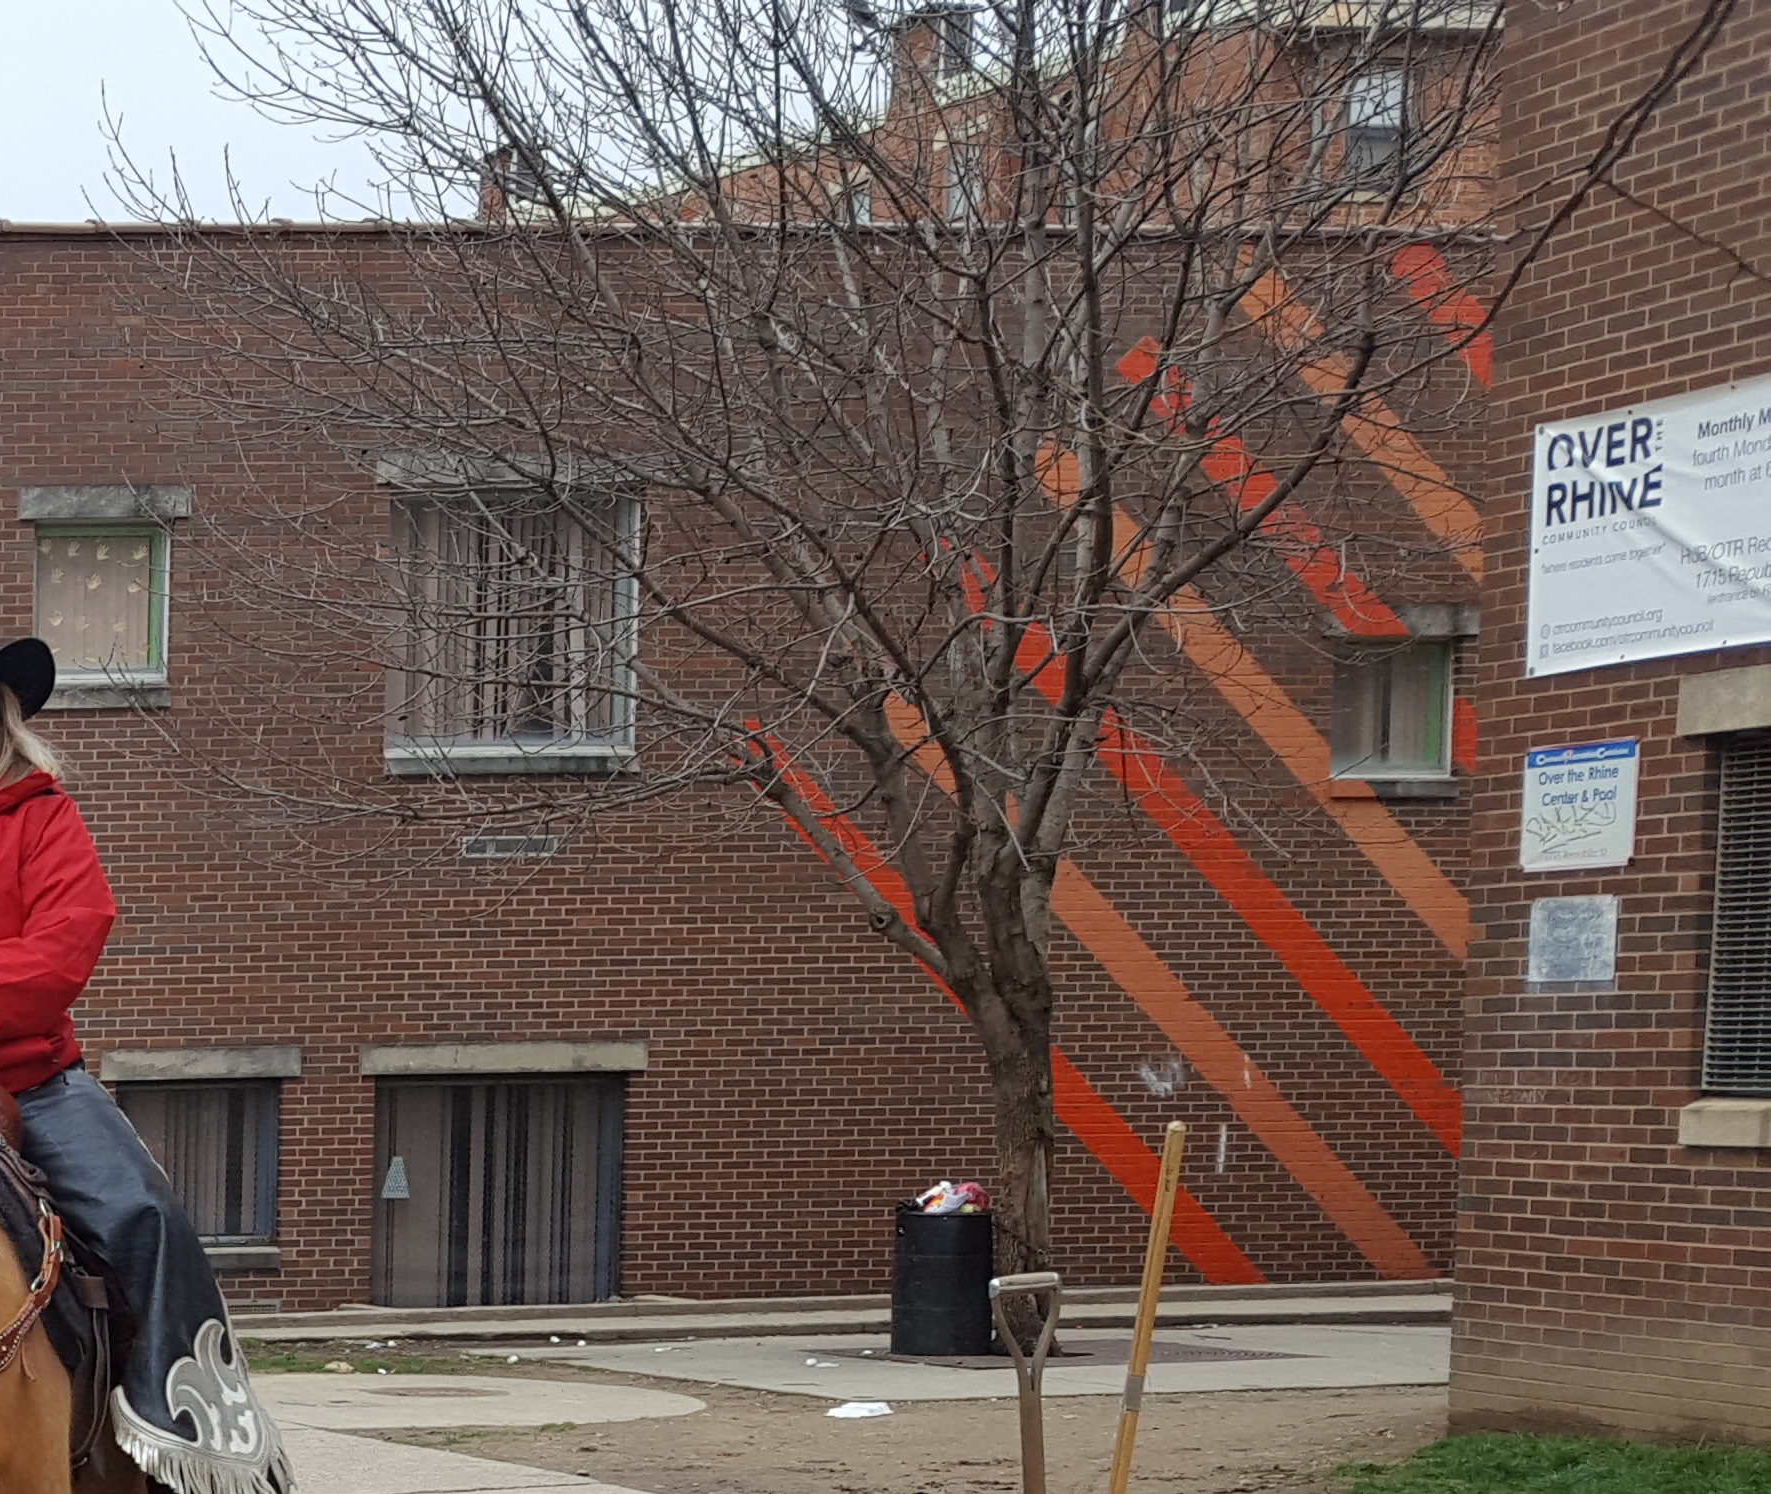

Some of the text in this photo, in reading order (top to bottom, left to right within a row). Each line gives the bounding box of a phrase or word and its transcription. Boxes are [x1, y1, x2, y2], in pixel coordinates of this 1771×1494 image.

[1698, 412, 1755, 440] Monthly
[1547, 417, 1653, 471] OVER
[1692, 444, 1730, 466] fourth
[1704, 467, 1746, 491] month
[1749, 464, 1762, 481] at
[1546, 463, 1663, 527] RHINE
[1542, 525, 1608, 545] COMMUNITY
[1680, 538, 1744, 566] HUB/OTR
[1696, 568, 1726, 589] 1715
[1539, 765, 1620, 785] Over the Rhine
[1541, 785, 1618, 807] Center & Pool
